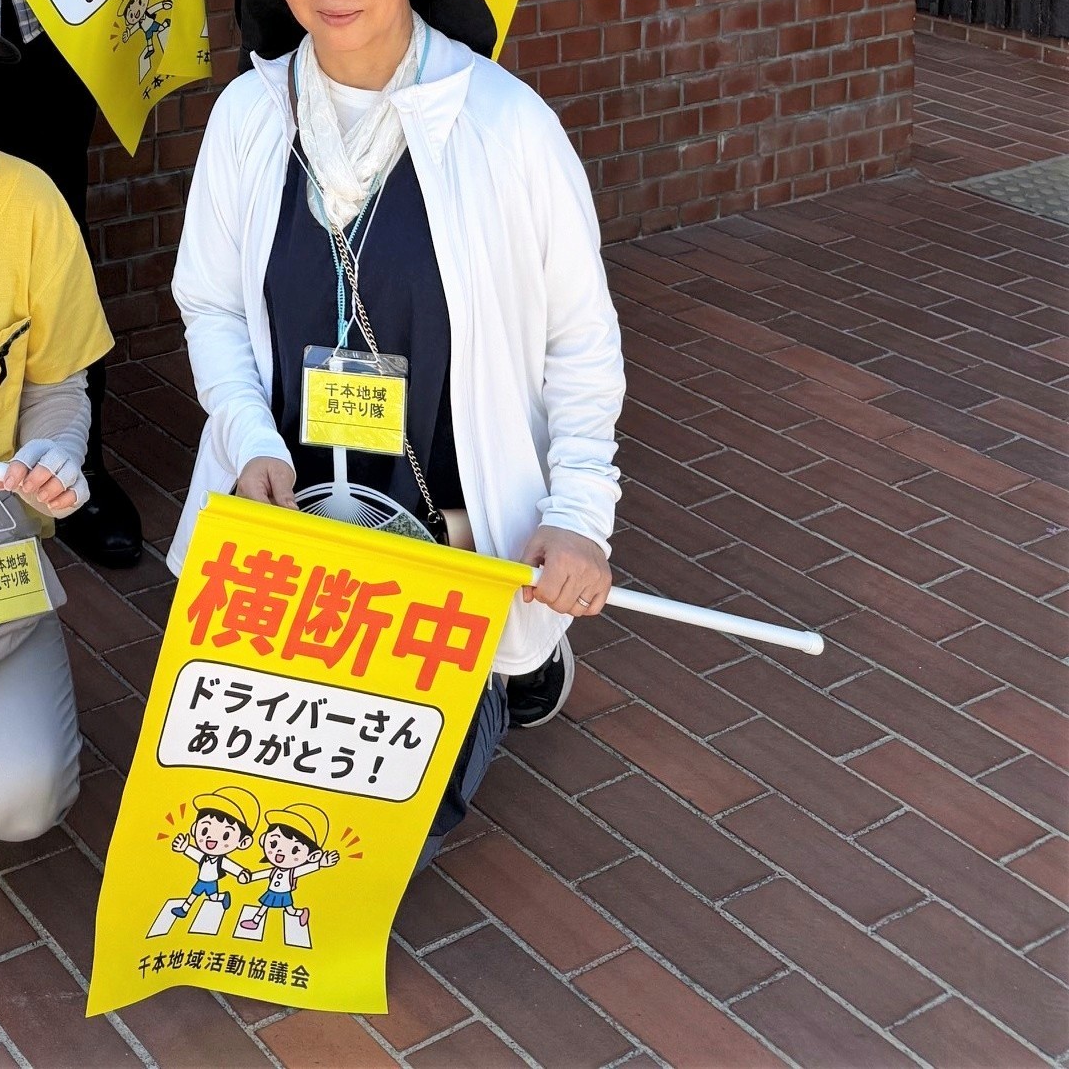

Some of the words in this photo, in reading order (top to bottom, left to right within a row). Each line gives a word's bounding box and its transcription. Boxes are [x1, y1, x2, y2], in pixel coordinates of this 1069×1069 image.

[324, 382, 388, 403] 千本地域
[325, 398, 386, 419] 見守り隊
[187, 541, 490, 692] 横断中
[187, 676, 423, 751] ドライバーさん
[187, 721, 385, 784] ありがとう！
[137, 948, 311, 991] 千本地域活動協議会
